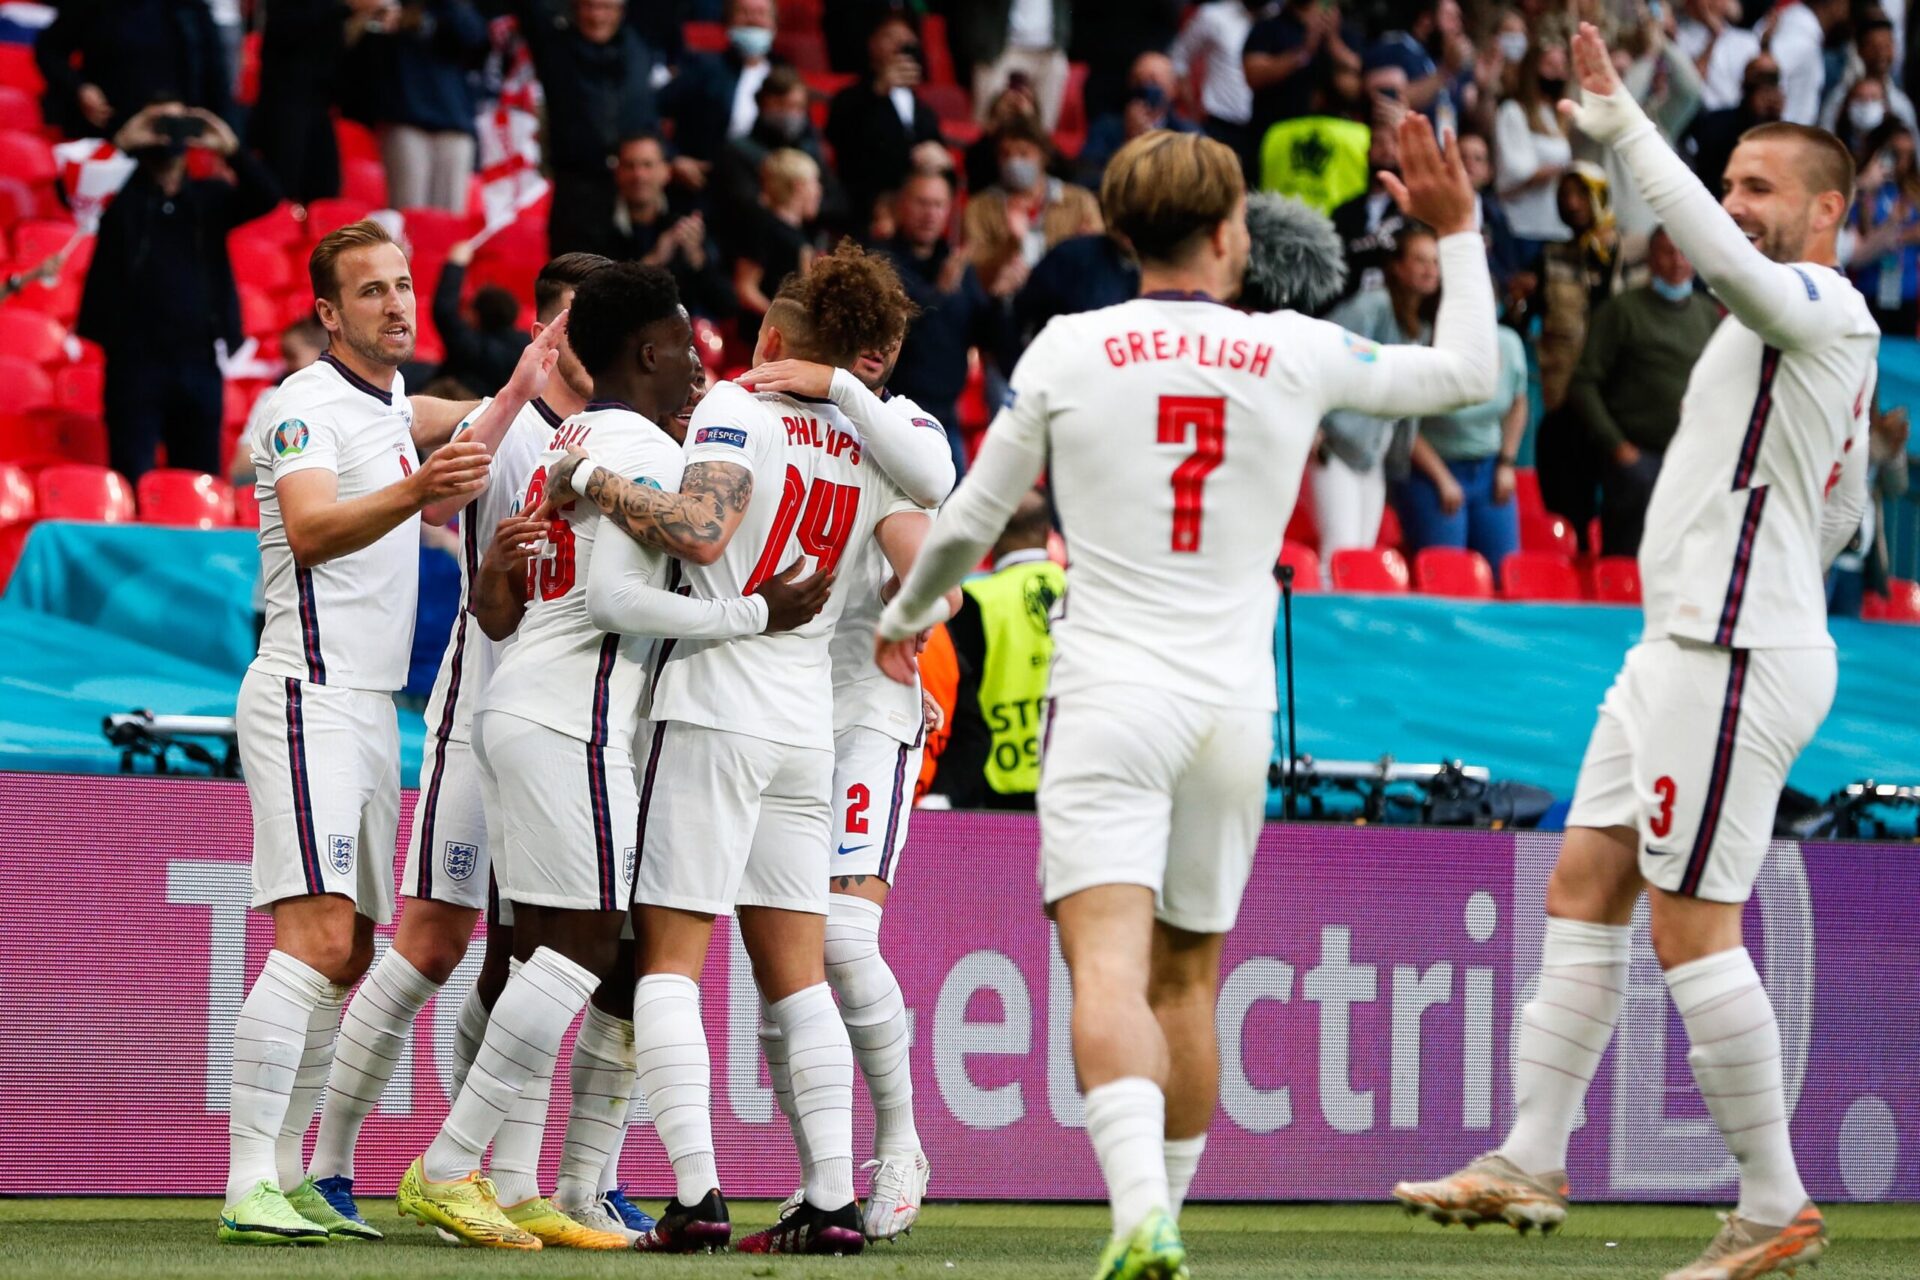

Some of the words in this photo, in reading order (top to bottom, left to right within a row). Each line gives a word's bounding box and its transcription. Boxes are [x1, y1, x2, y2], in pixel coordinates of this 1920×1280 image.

[1104, 329, 1275, 378] GREALISH
[706, 430, 746, 445] RESPECT
[1156, 394, 1228, 553] 7
[845, 782, 870, 835] 2
[1649, 774, 1676, 839] 3
